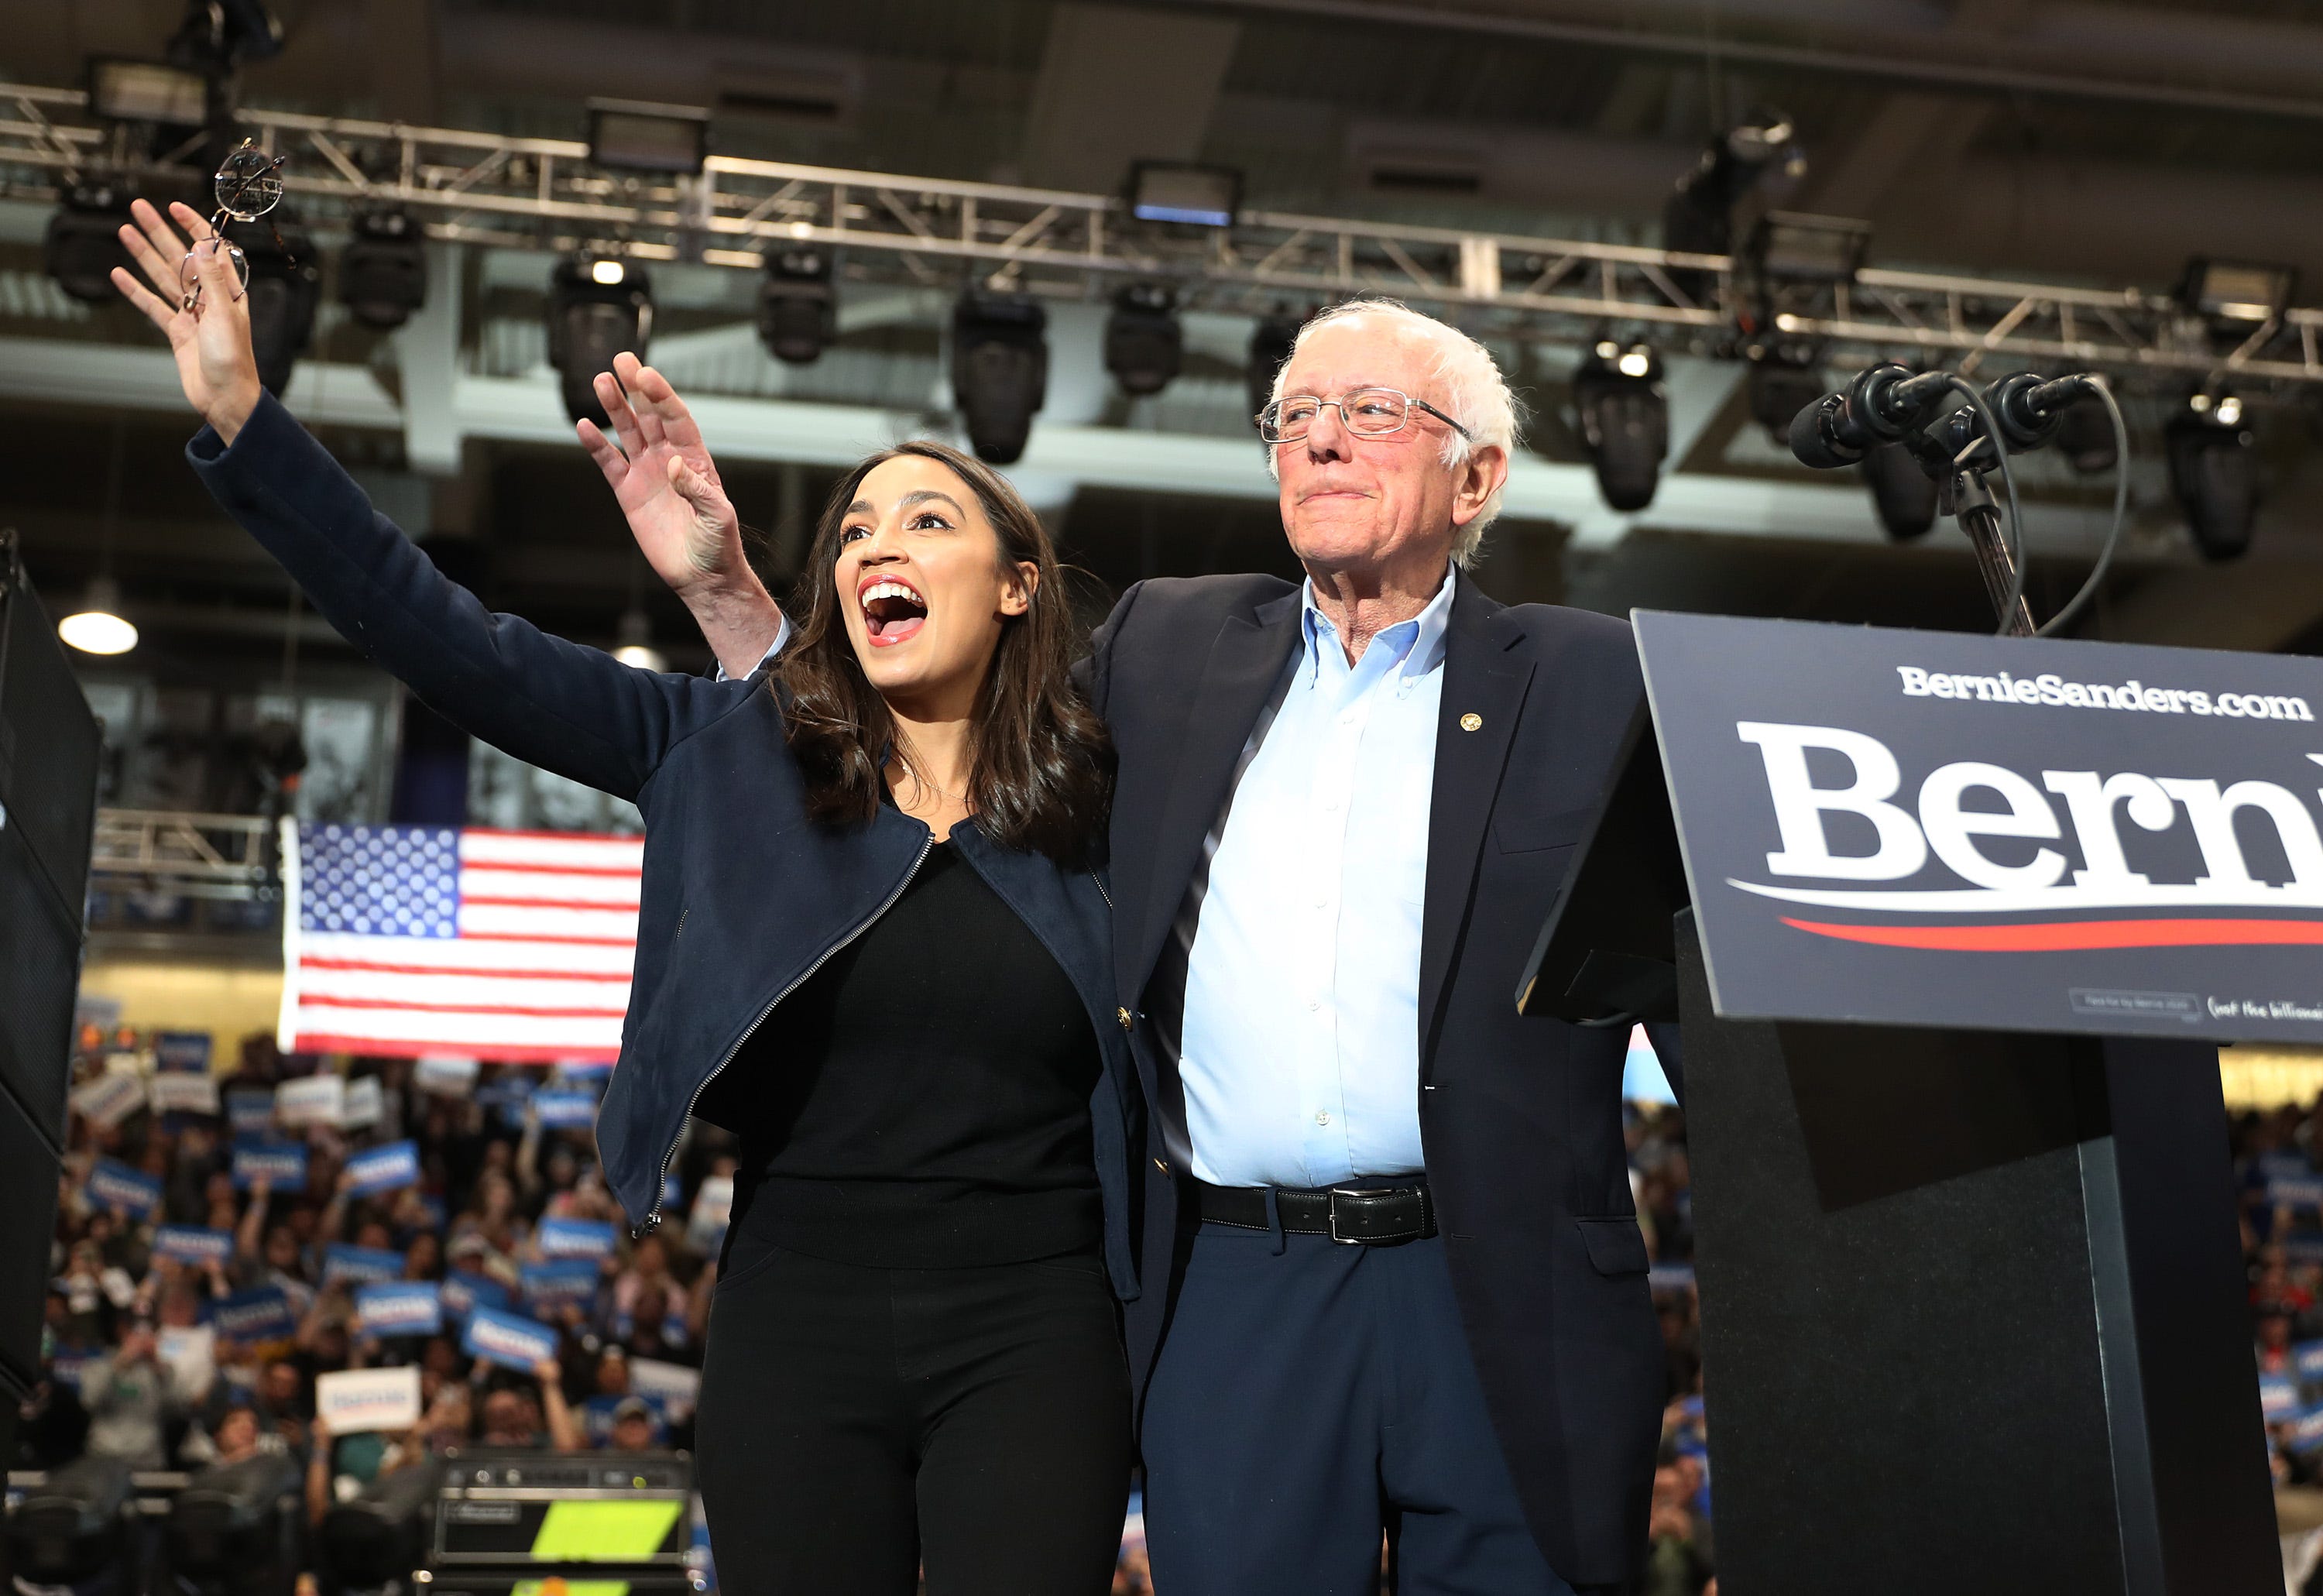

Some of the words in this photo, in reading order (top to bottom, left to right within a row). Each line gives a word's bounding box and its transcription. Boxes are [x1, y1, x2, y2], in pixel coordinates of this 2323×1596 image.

[1897, 664, 2315, 722] BernieSanders.com
[1736, 720, 2323, 889] Bern
[2208, 996, 2239, 1020] (not
[2242, 1001, 2269, 1019] the
